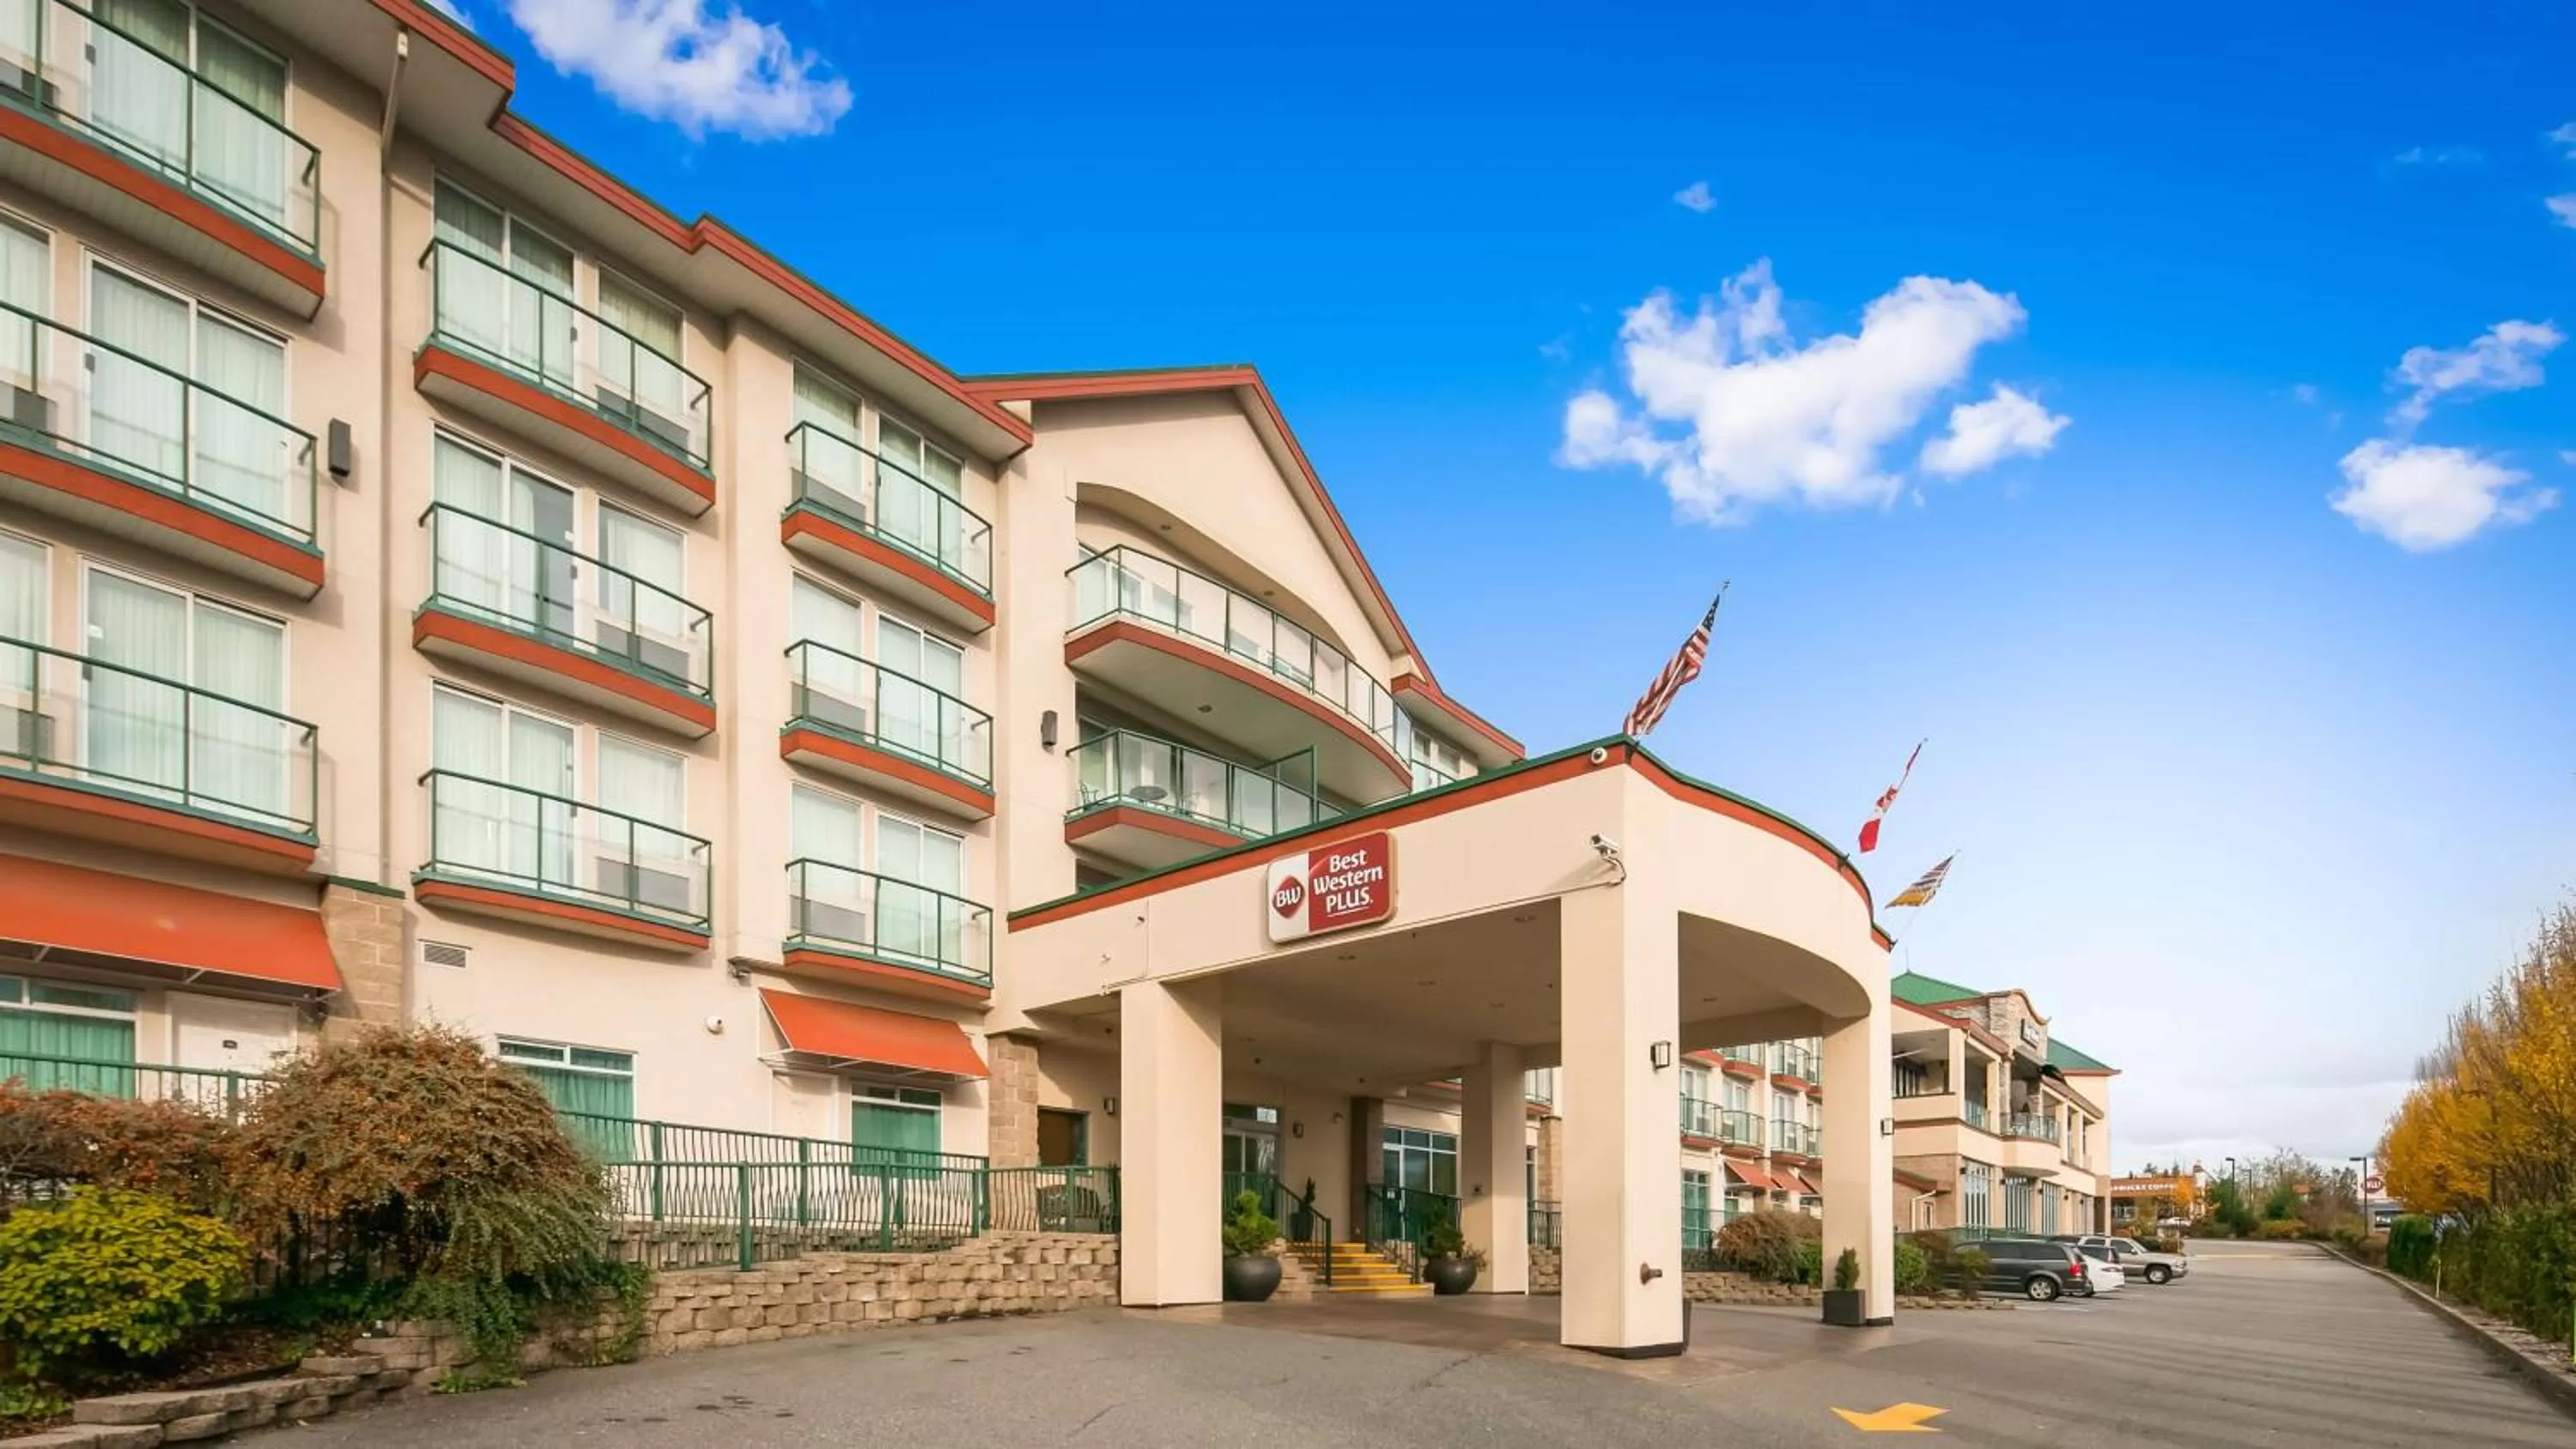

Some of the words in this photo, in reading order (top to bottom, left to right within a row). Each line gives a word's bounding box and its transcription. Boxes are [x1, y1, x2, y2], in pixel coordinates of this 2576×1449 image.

[1329, 849, 1367, 873] Best
[1314, 865, 1383, 894] Western
[1277, 886, 1301, 907] BW
